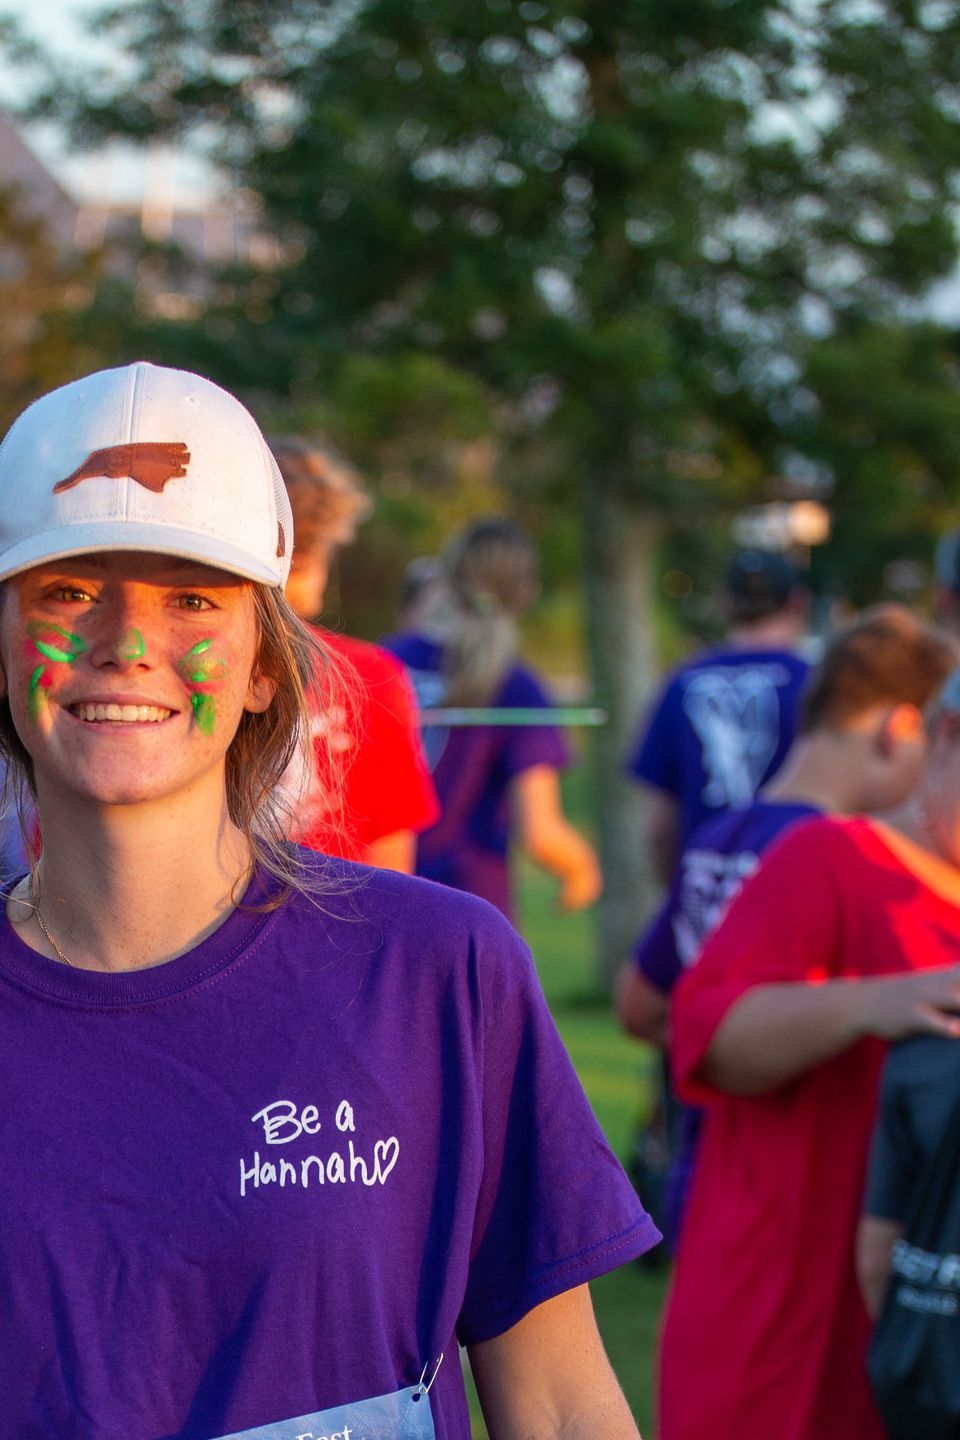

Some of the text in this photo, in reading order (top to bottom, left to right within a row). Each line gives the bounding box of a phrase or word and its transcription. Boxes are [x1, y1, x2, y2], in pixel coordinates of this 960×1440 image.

[251, 1099, 356, 1145] Be a
[239, 1139, 378, 1197] Hannah
